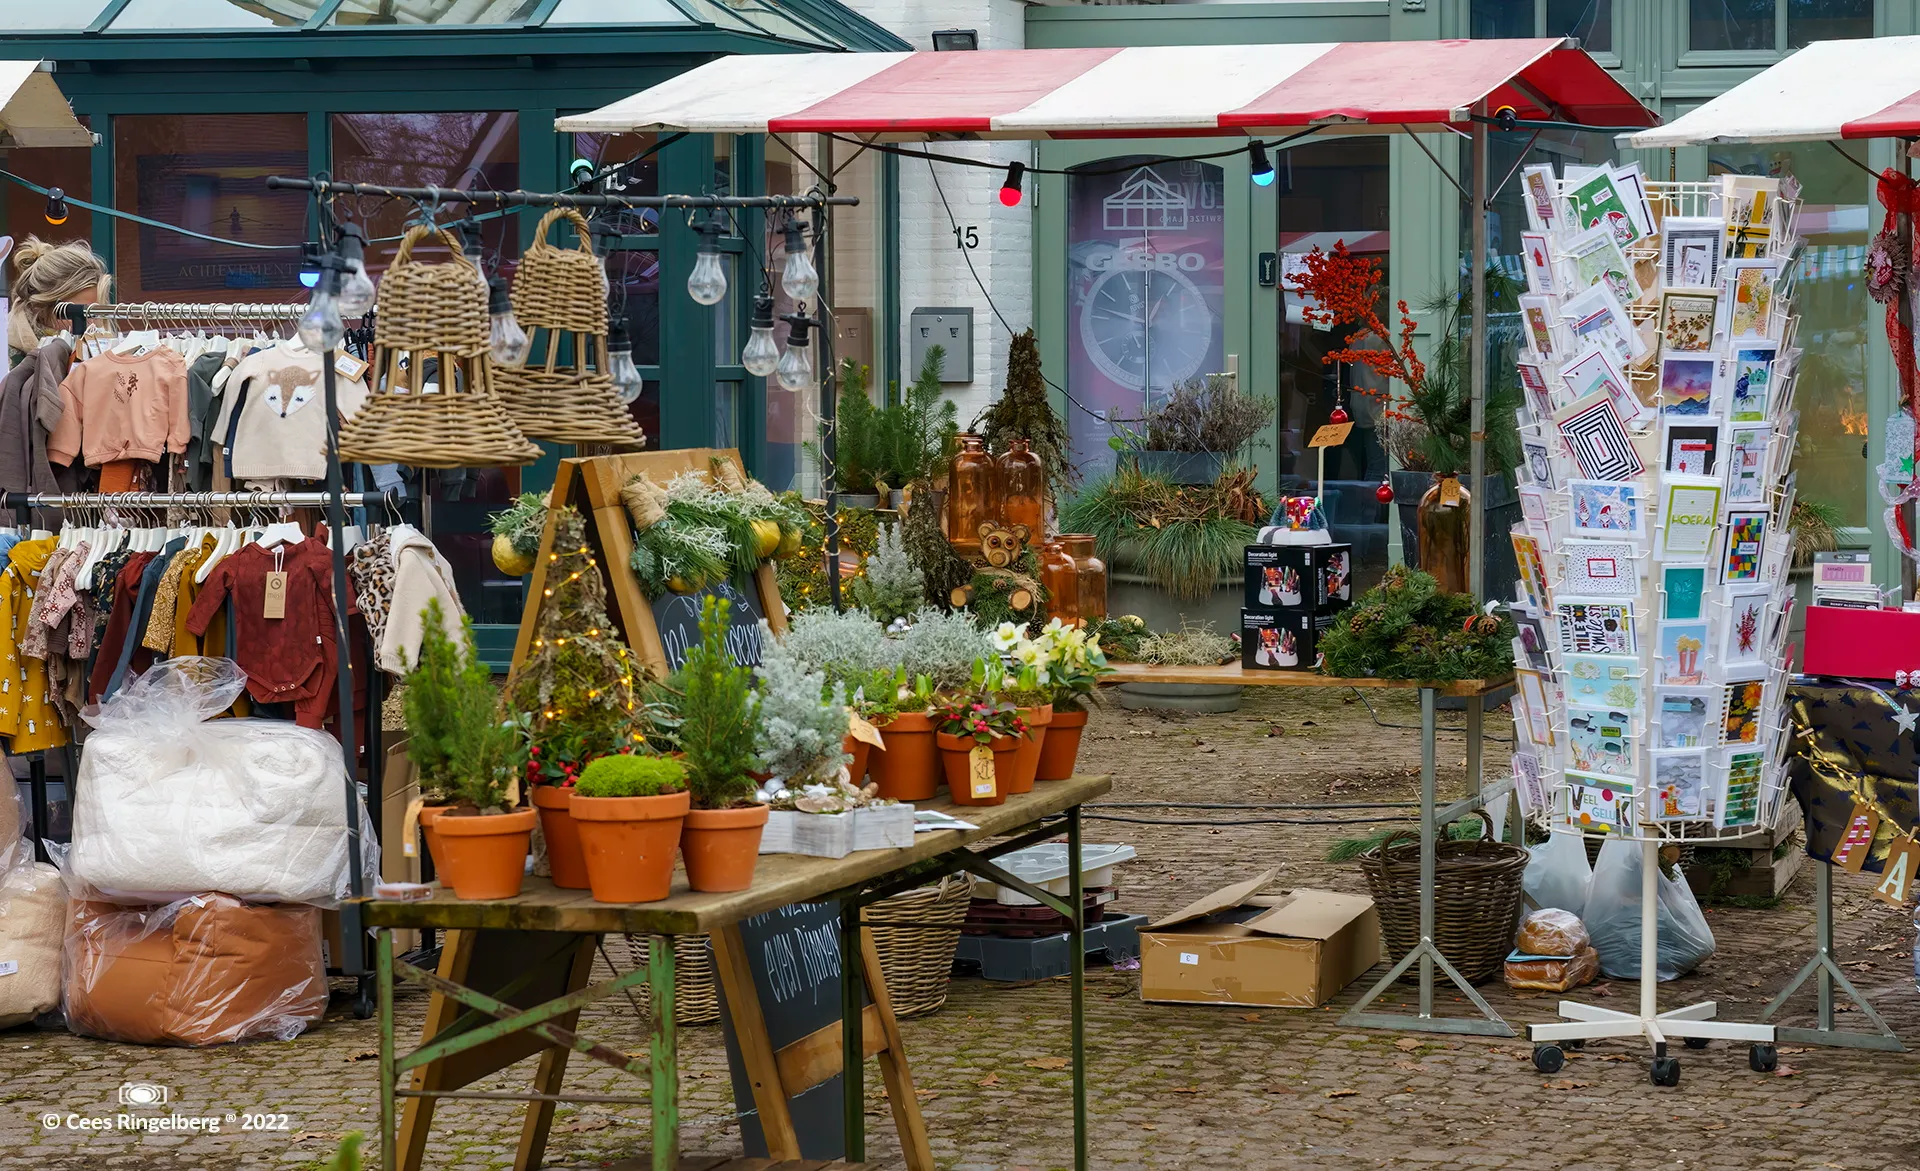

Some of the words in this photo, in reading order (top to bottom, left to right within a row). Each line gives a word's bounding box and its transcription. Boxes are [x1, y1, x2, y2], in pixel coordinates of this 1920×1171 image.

[953, 226, 979, 249] 15
[179, 263, 296, 277] ACHIEVEMENT
[1671, 515, 1711, 525] HOERA
[1836, 815, 1871, 863] P
[1877, 851, 1909, 901] A
